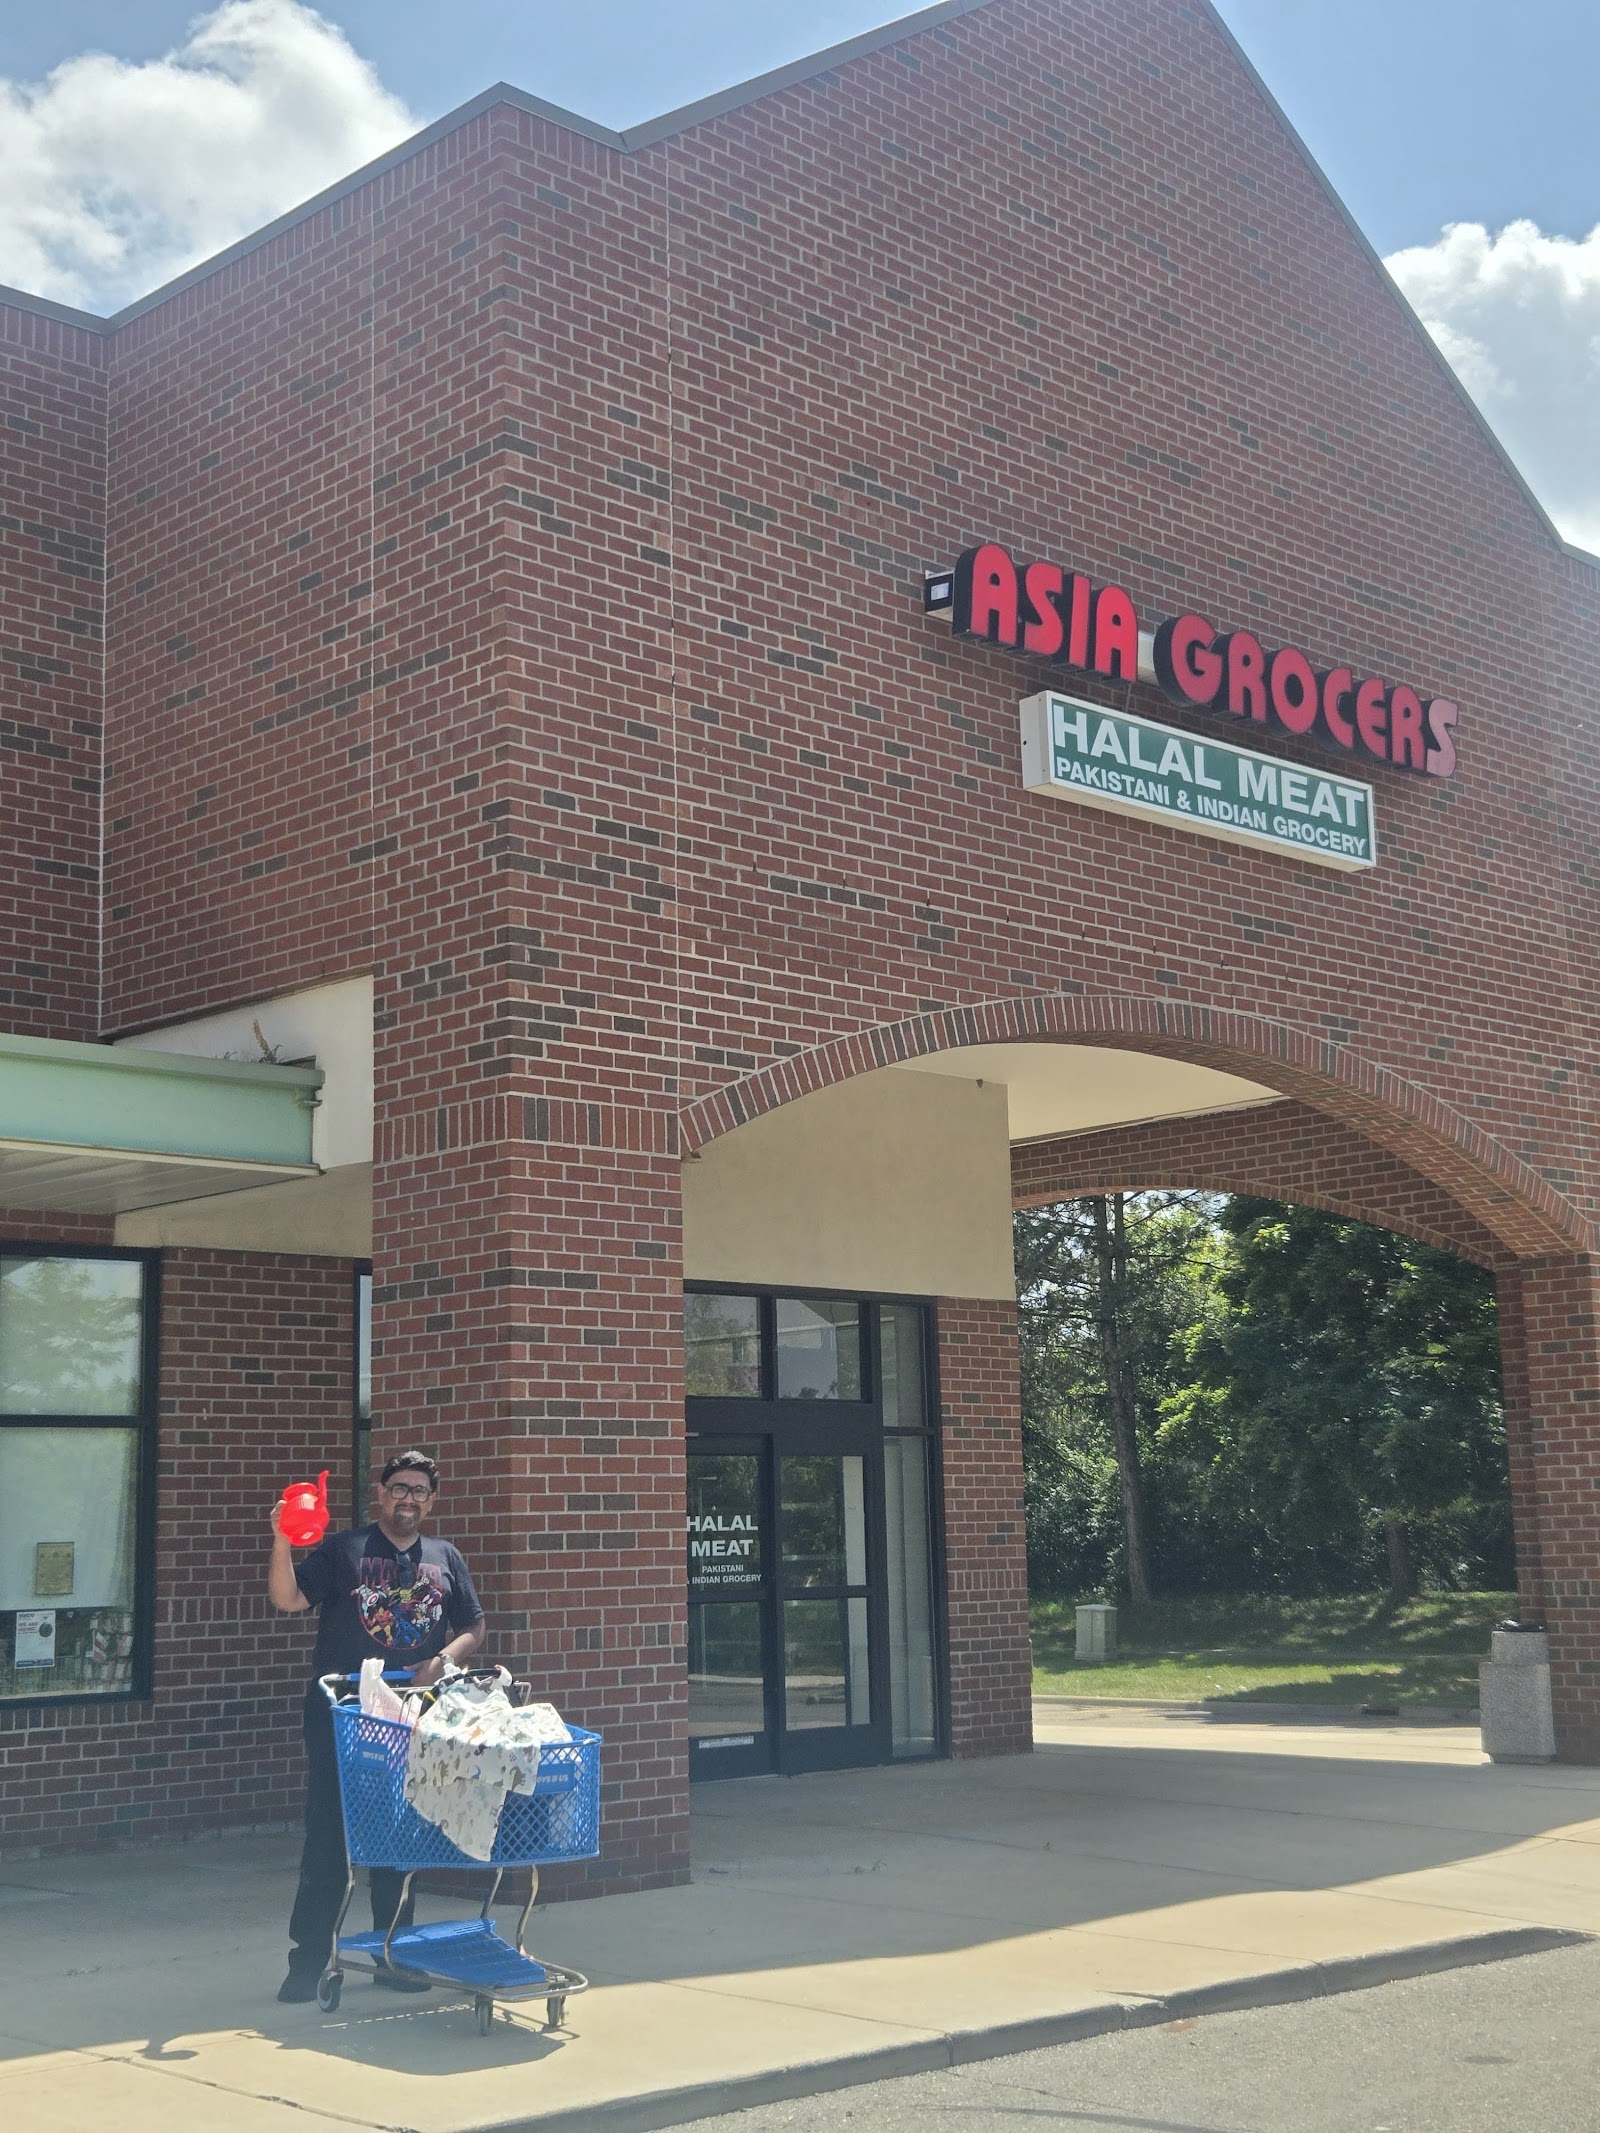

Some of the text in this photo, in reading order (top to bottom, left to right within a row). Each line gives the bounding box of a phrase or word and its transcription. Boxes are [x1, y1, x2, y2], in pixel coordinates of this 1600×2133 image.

[970, 542, 1459, 779] ASIA GROCERS
[1053, 704, 1365, 828] HALAL MEAT
[1056, 755, 1367, 857] PAKISTANI & INDIAN GROCERY
[687, 1515, 758, 1531] HALAL
[692, 1539, 753, 1557] MEAT
[702, 1564, 744, 1574] PAKISTANI
[692, 1575, 721, 1584] INDIAN
[722, 1574, 762, 1583] GROCERY
